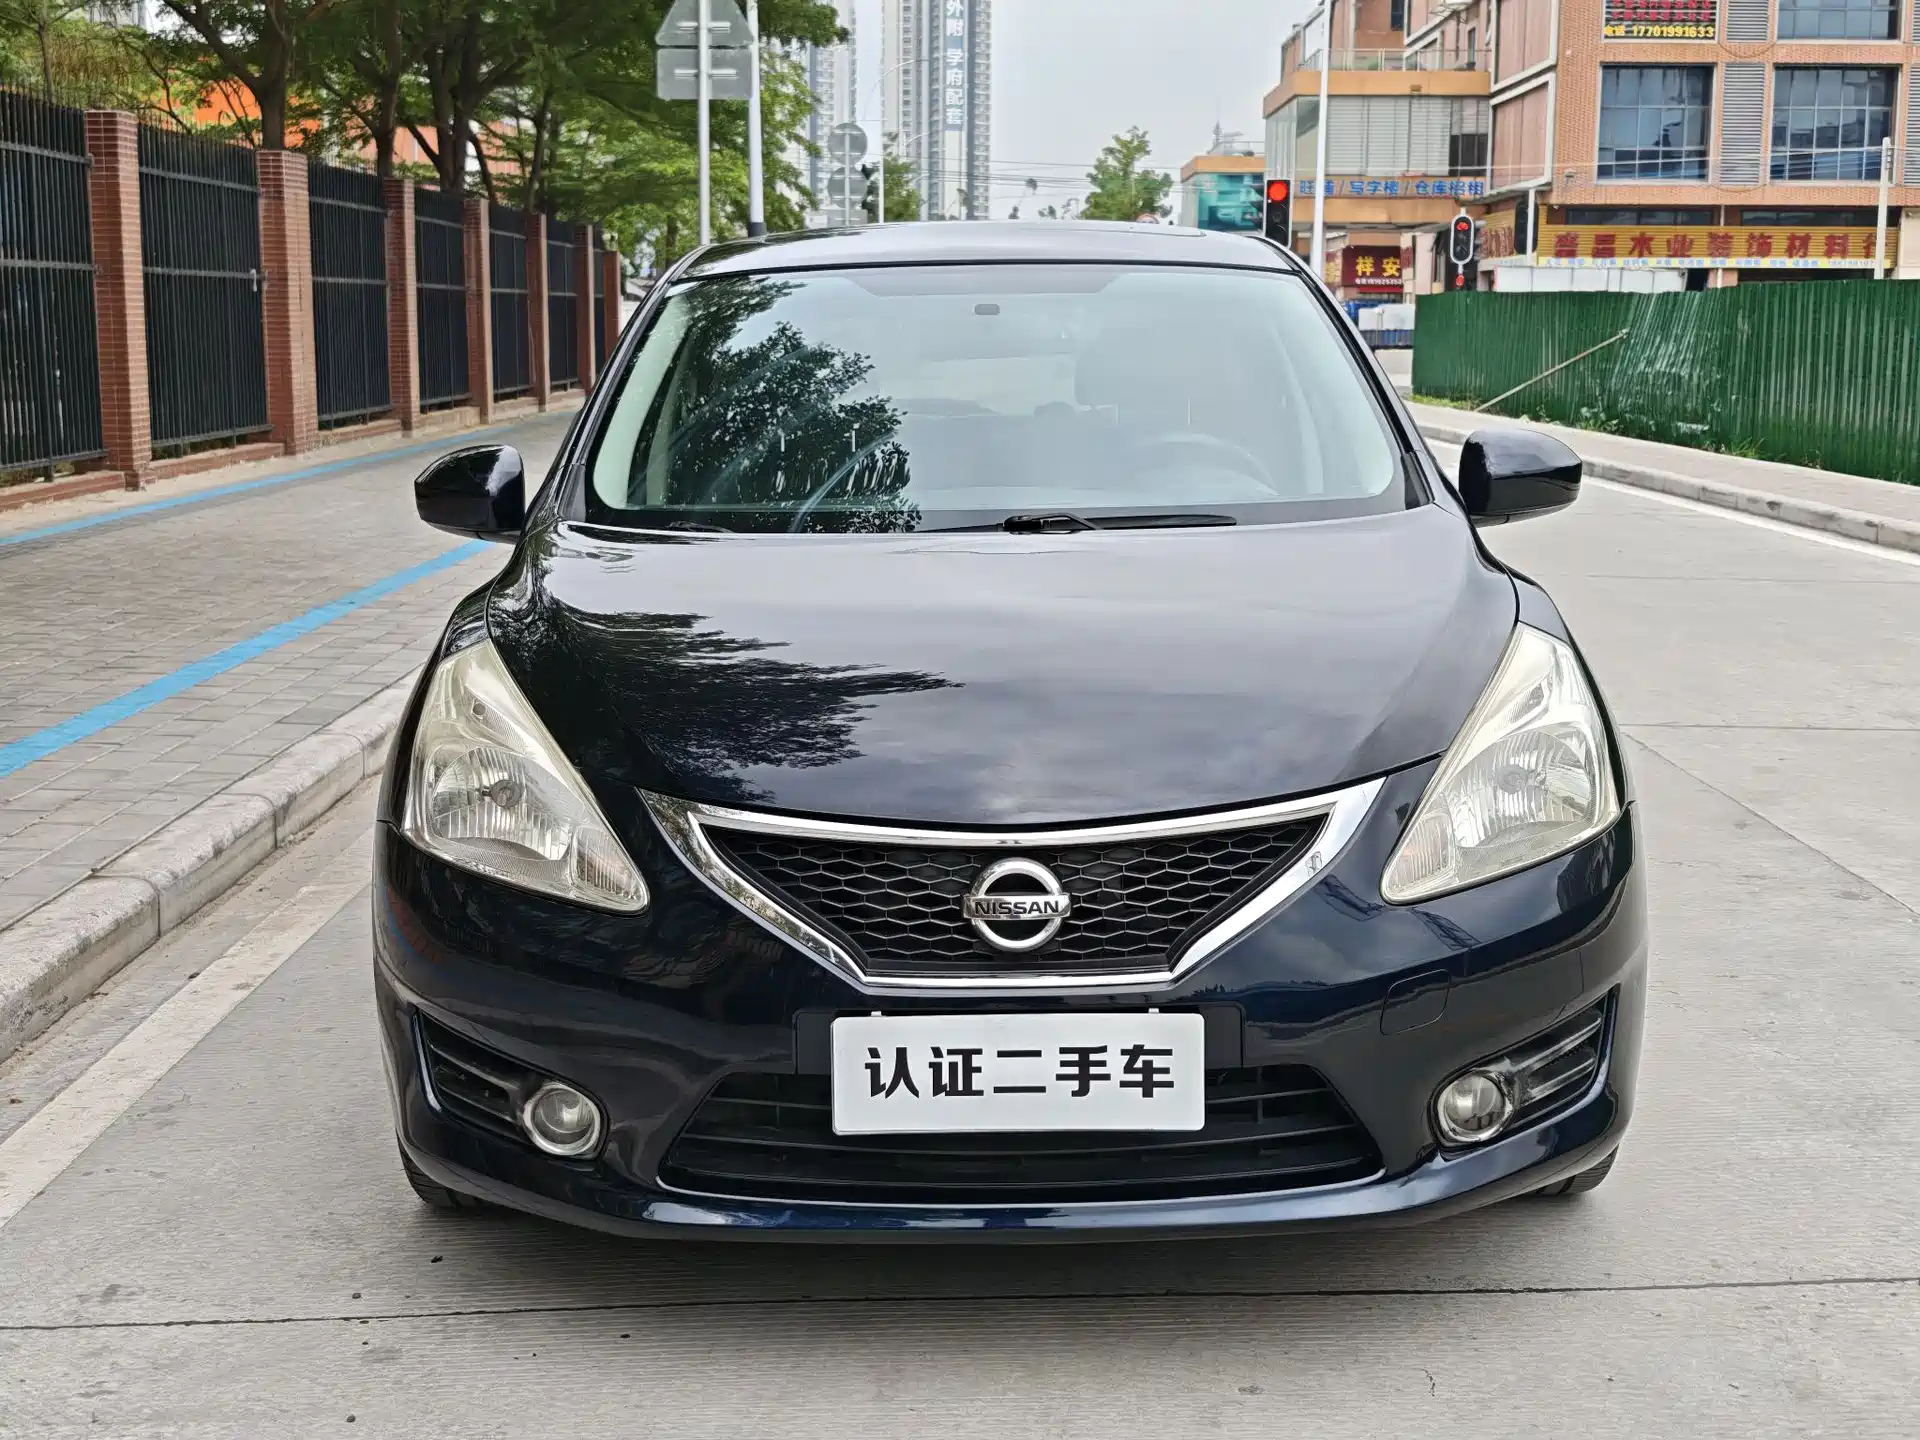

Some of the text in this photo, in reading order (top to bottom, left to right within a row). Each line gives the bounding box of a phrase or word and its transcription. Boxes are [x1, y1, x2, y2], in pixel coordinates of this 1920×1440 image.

[1632, 25, 1714, 38] 17701991633
[1355, 255, 1401, 277] 祥安
[974, 901, 1059, 915] NISSAN
[864, 1044, 1175, 1099] 认证二手车
